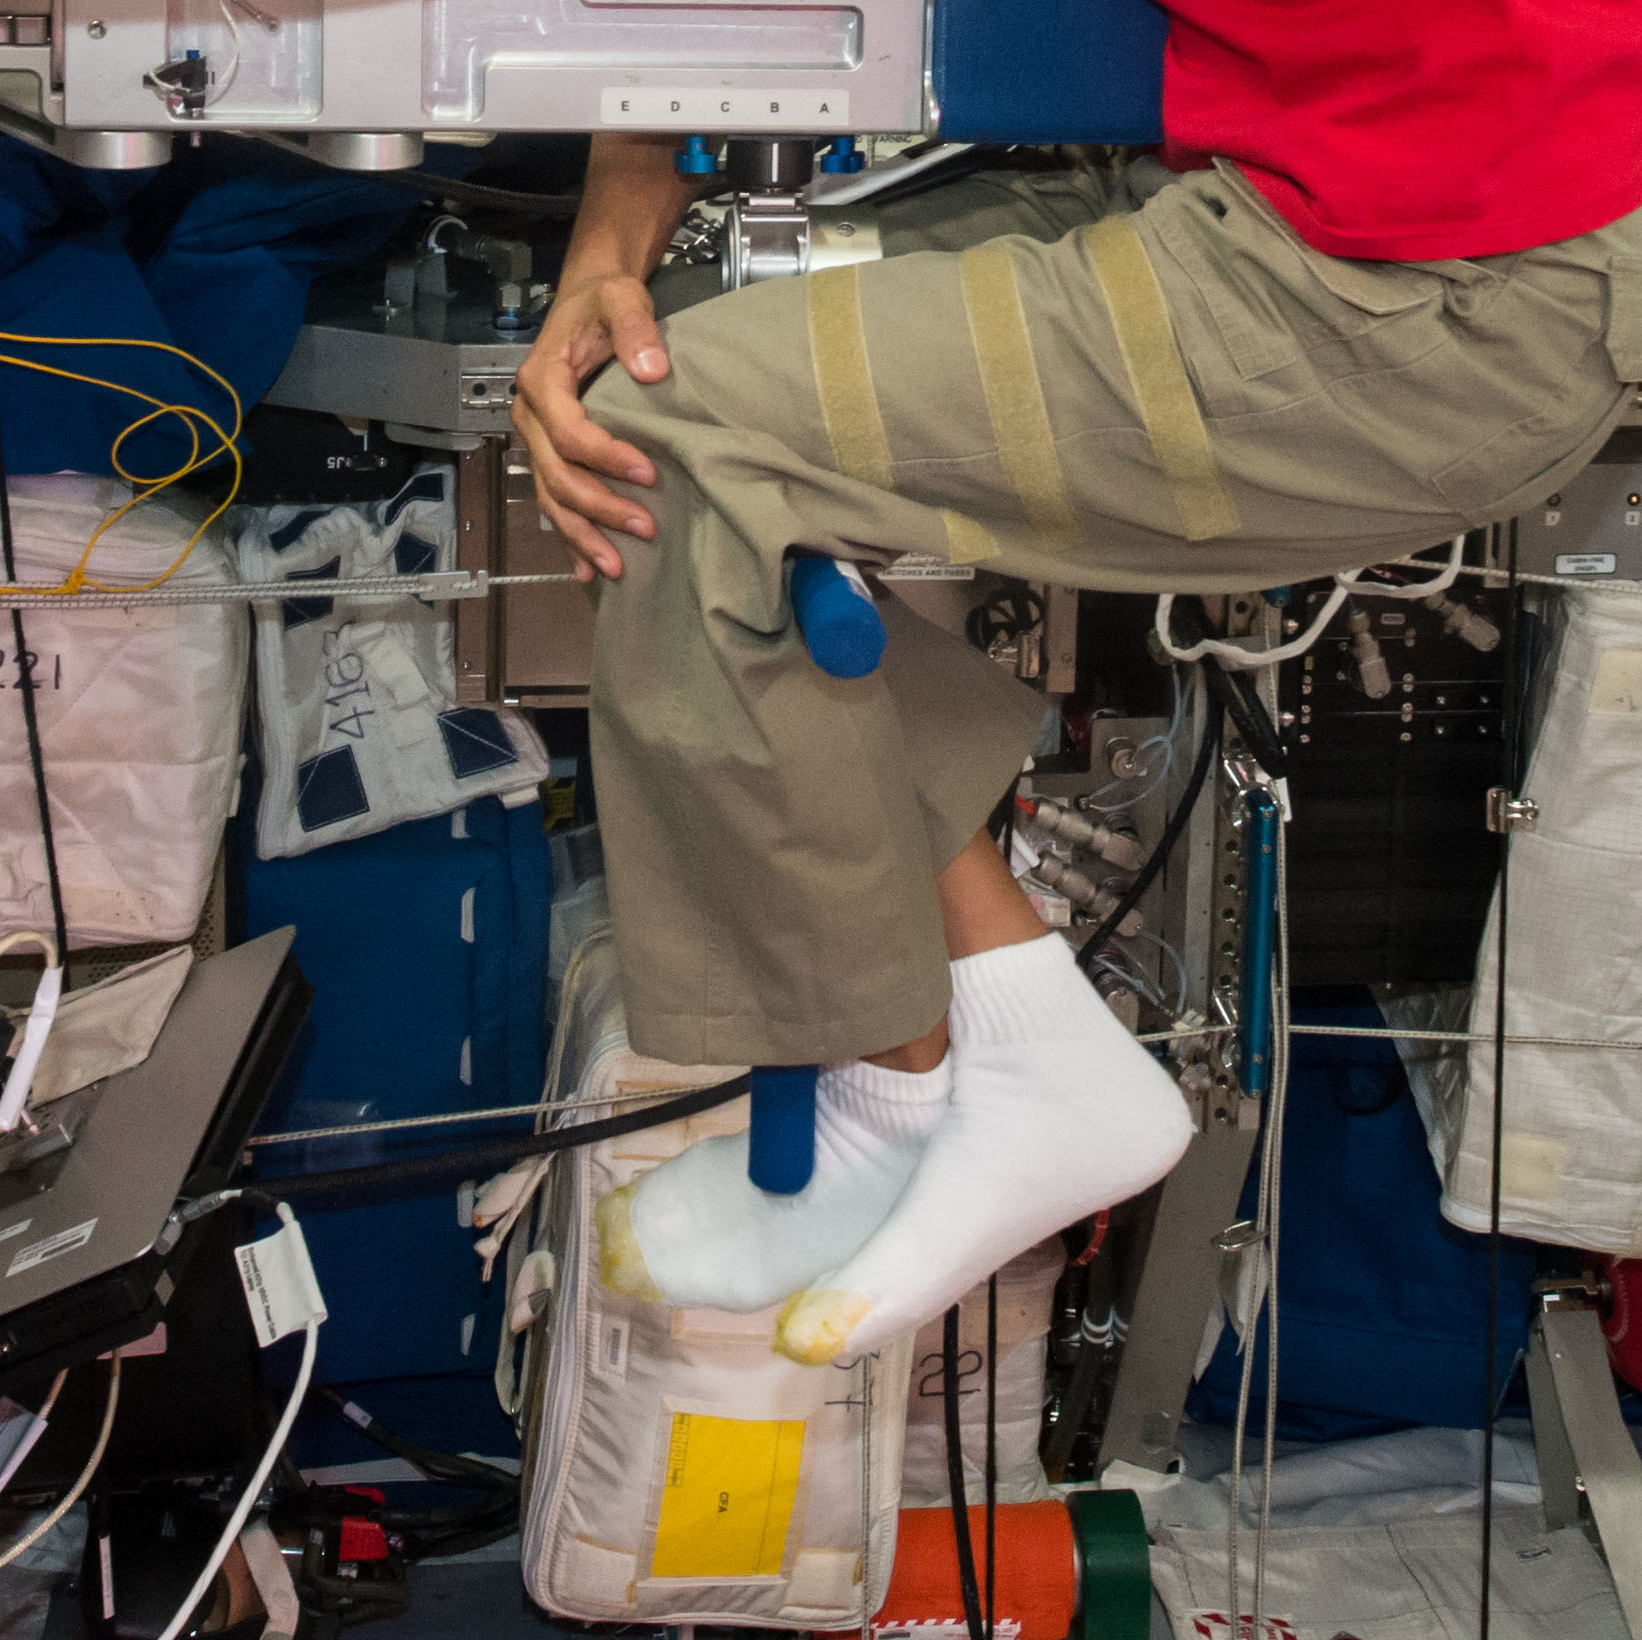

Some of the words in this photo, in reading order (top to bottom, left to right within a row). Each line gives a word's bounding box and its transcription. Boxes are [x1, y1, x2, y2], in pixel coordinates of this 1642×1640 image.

[620, 100, 630, 113] E
[670, 100, 681, 113] D
[720, 100, 731, 113] C
[769, 100, 780, 113] B
[818, 100, 830, 113] A
[326, 454, 350, 469] J5
[717, 1490, 729, 1515] CFA
